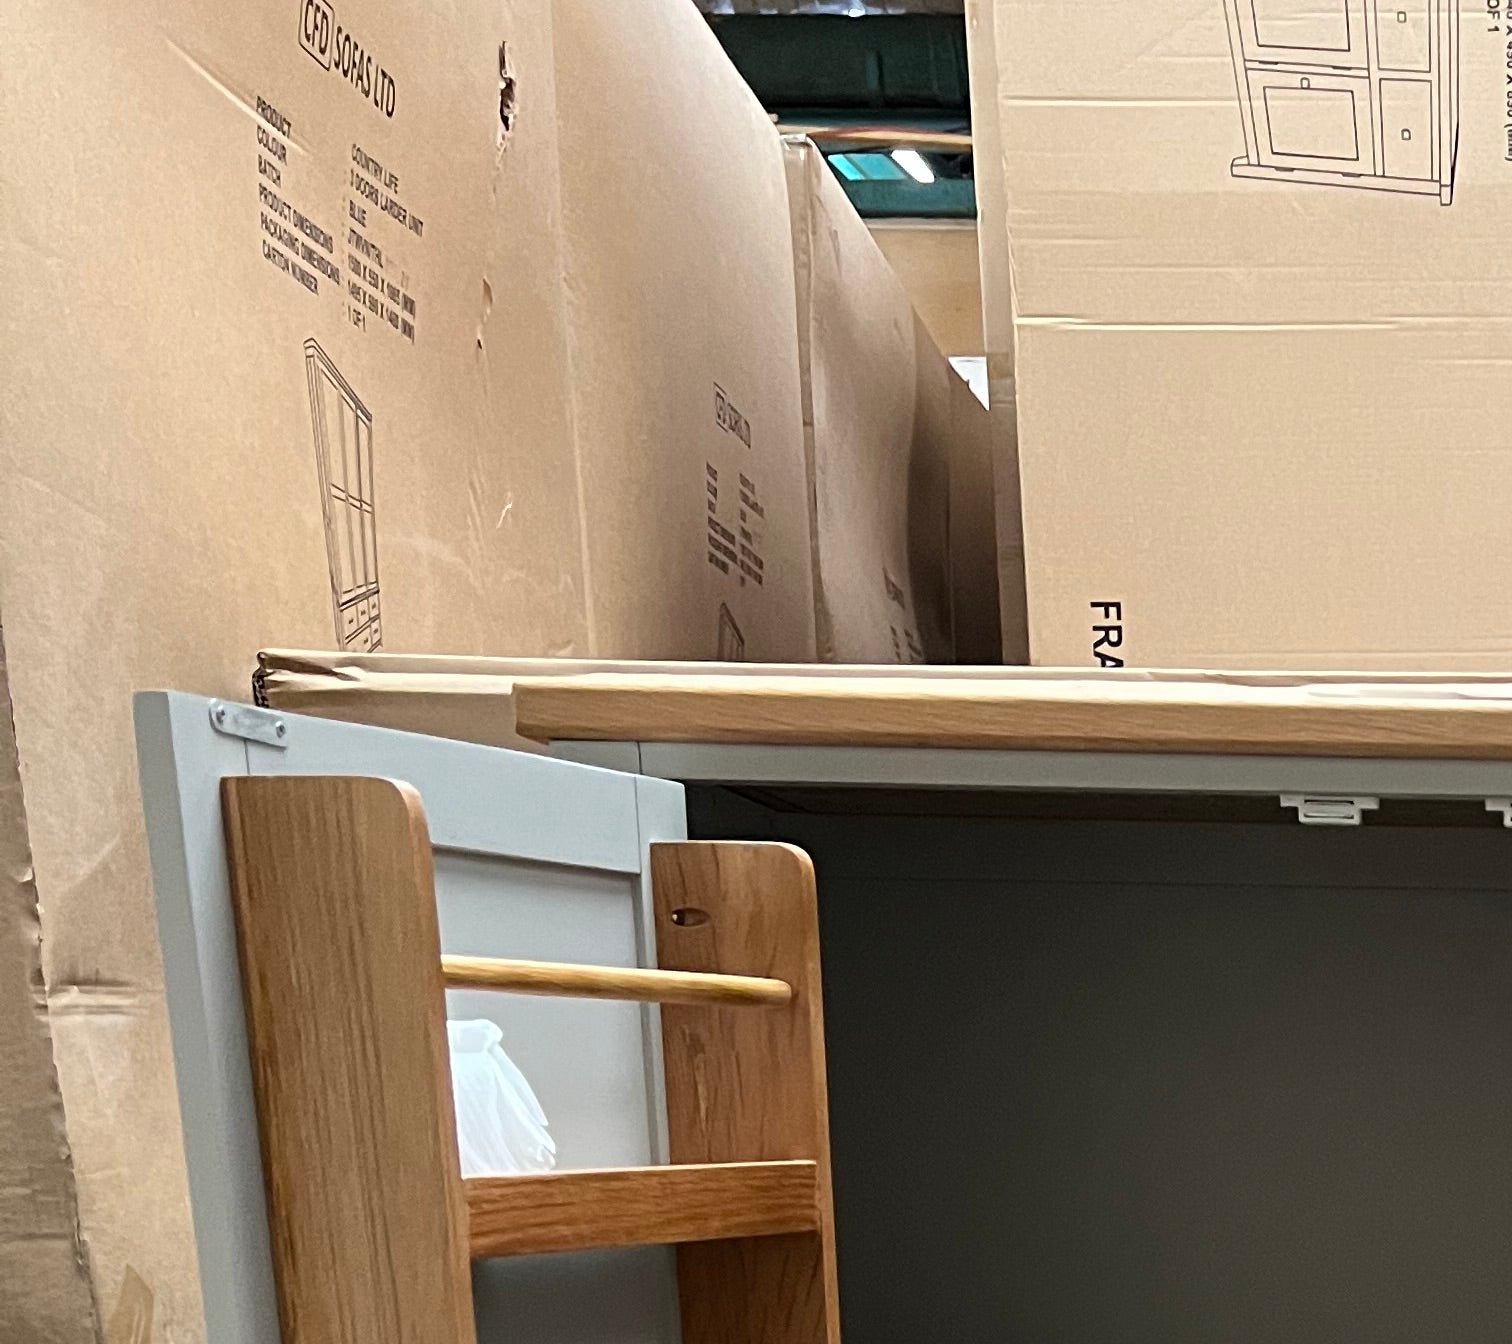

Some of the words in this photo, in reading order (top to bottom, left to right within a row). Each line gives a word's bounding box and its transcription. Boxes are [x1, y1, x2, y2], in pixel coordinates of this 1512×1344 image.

[304, 0, 329, 56] CFD
[333, 25, 374, 99] SOFAS
[373, 65, 396, 118] LTD
